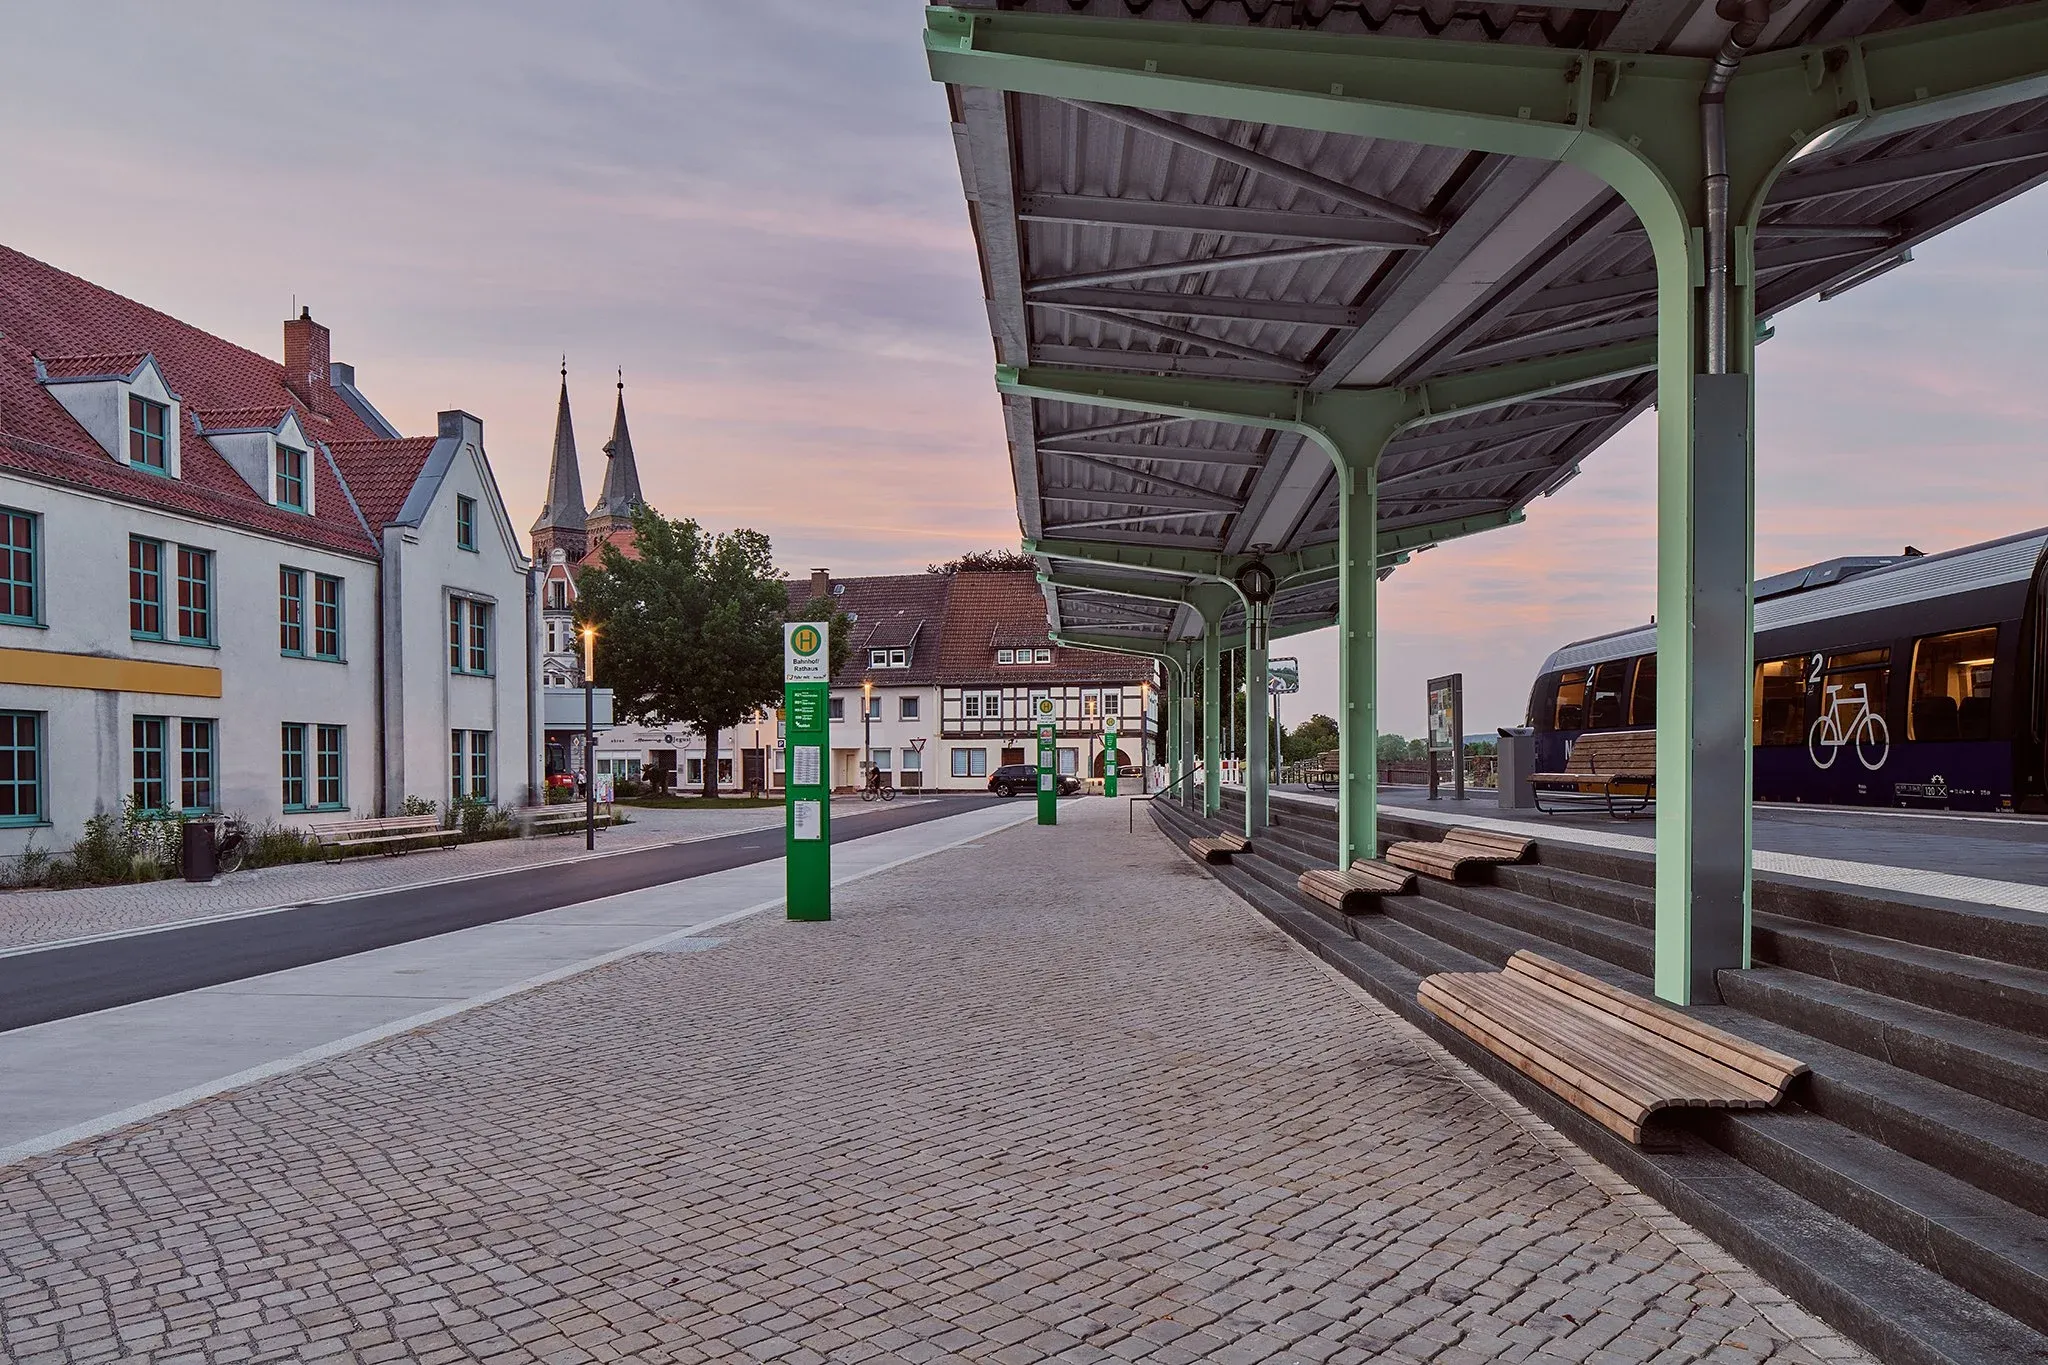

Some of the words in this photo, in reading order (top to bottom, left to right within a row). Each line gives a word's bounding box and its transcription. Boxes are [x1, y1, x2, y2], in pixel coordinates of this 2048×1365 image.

[800, 632, 812, 650] H
[1586, 666, 1595, 686] 2
[1808, 653, 1824, 683] 2
[1565, 739, 1572, 760] N
[1925, 787, 1935, 796] 120
